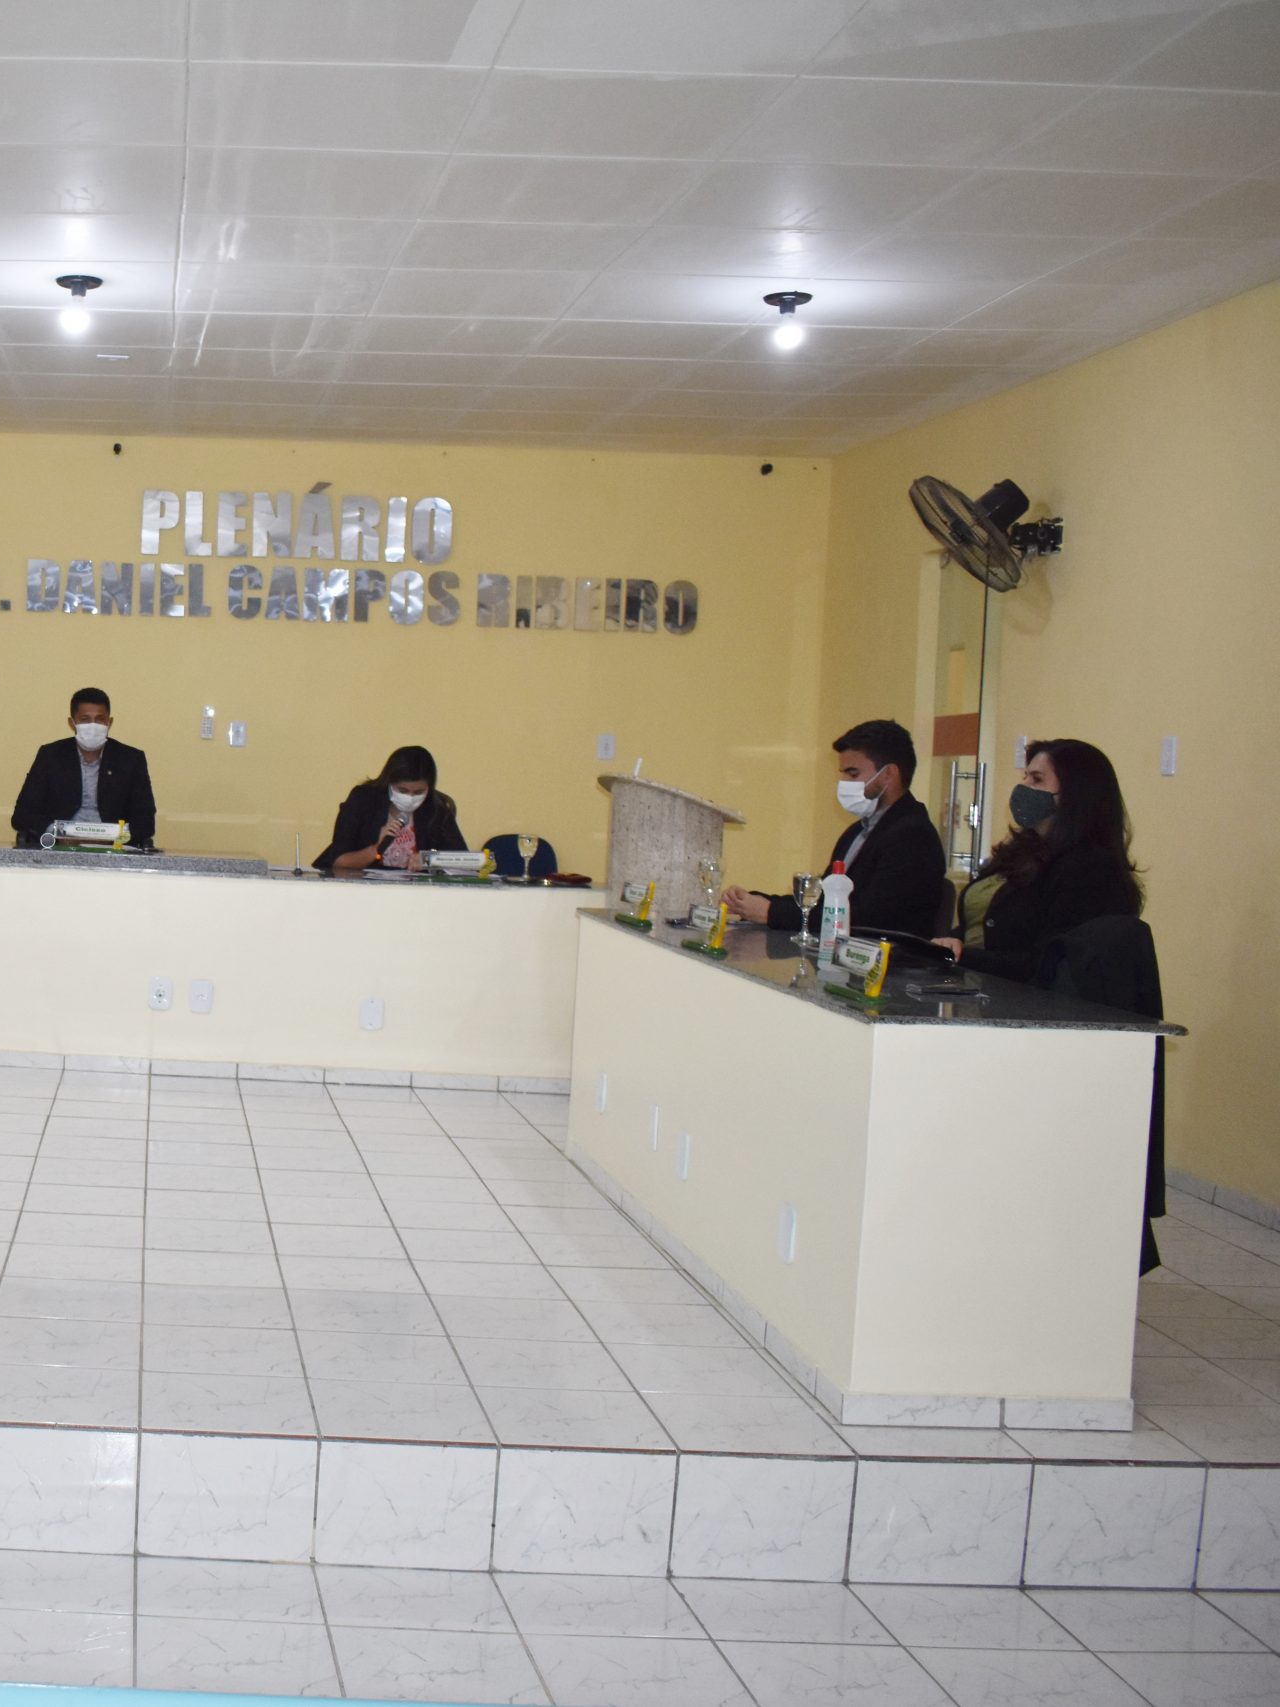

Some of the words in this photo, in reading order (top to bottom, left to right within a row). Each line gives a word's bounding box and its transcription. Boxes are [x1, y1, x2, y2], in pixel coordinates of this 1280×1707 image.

[140, 481, 454, 565] PLENÁRIO
[26, 558, 213, 617] DANIEL
[227, 564, 462, 627] CAMPOS
[475, 572, 700, 636] RIBEIRO
